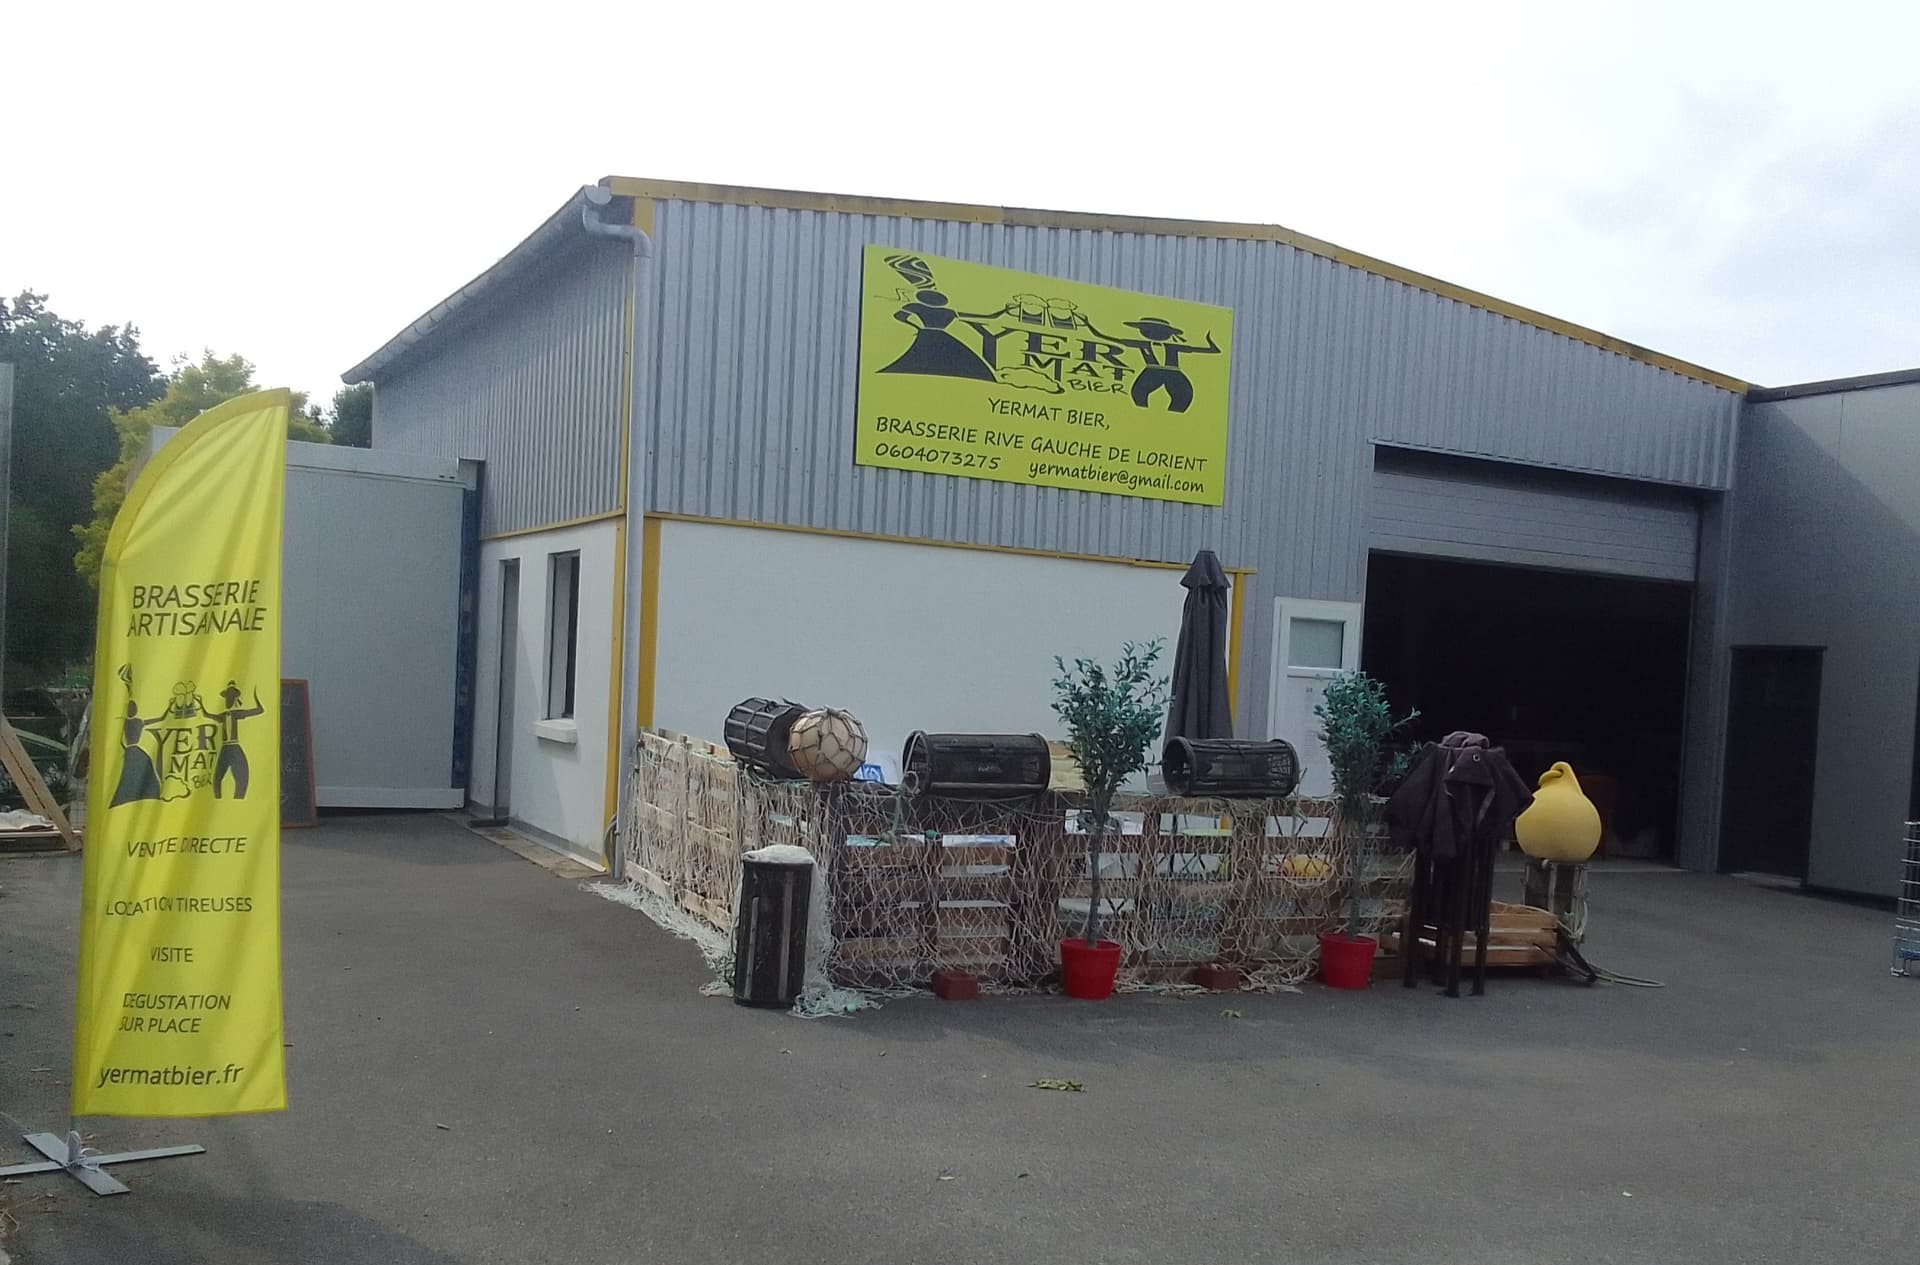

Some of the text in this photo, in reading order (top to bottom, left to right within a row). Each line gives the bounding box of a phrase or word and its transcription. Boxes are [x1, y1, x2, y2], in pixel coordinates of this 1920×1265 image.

[1066, 378, 1129, 395] BIER
[988, 397, 1111, 430] YERMAT BIER,
[876, 416, 1208, 472] BRASSERIE RIVE GAUCHE DE LORIENT
[875, 443, 1204, 493] 0604073275 yermatbier@gmail.com
[132, 580, 260, 609] BRASSERIE
[127, 607, 267, 637] ARTISANALE
[127, 837, 179, 857] VENTE
[176, 897, 252, 913] TIREUSES
[151, 947, 194, 963] VISITE
[147, 1017, 202, 1034] PLACE
[97, 1063, 245, 1088] yermatbier.fr
